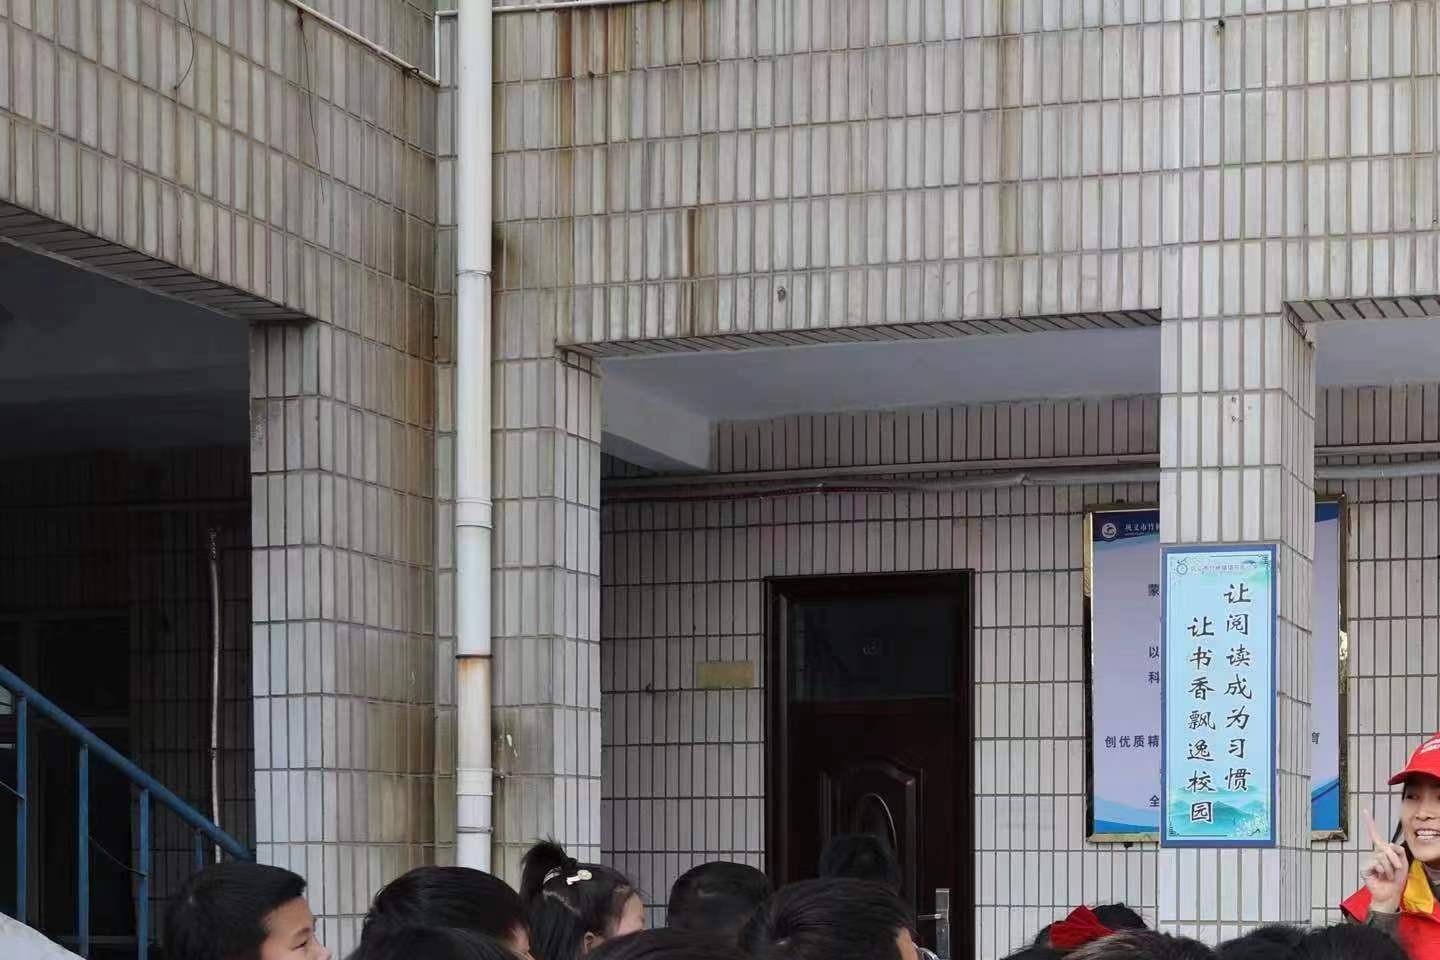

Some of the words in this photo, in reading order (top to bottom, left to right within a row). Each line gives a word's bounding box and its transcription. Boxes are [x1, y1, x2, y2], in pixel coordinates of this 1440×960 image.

[1186, 615, 1217, 824] 让书香飘逸校园
[1223, 582, 1253, 792] 让阅读成为习惯
